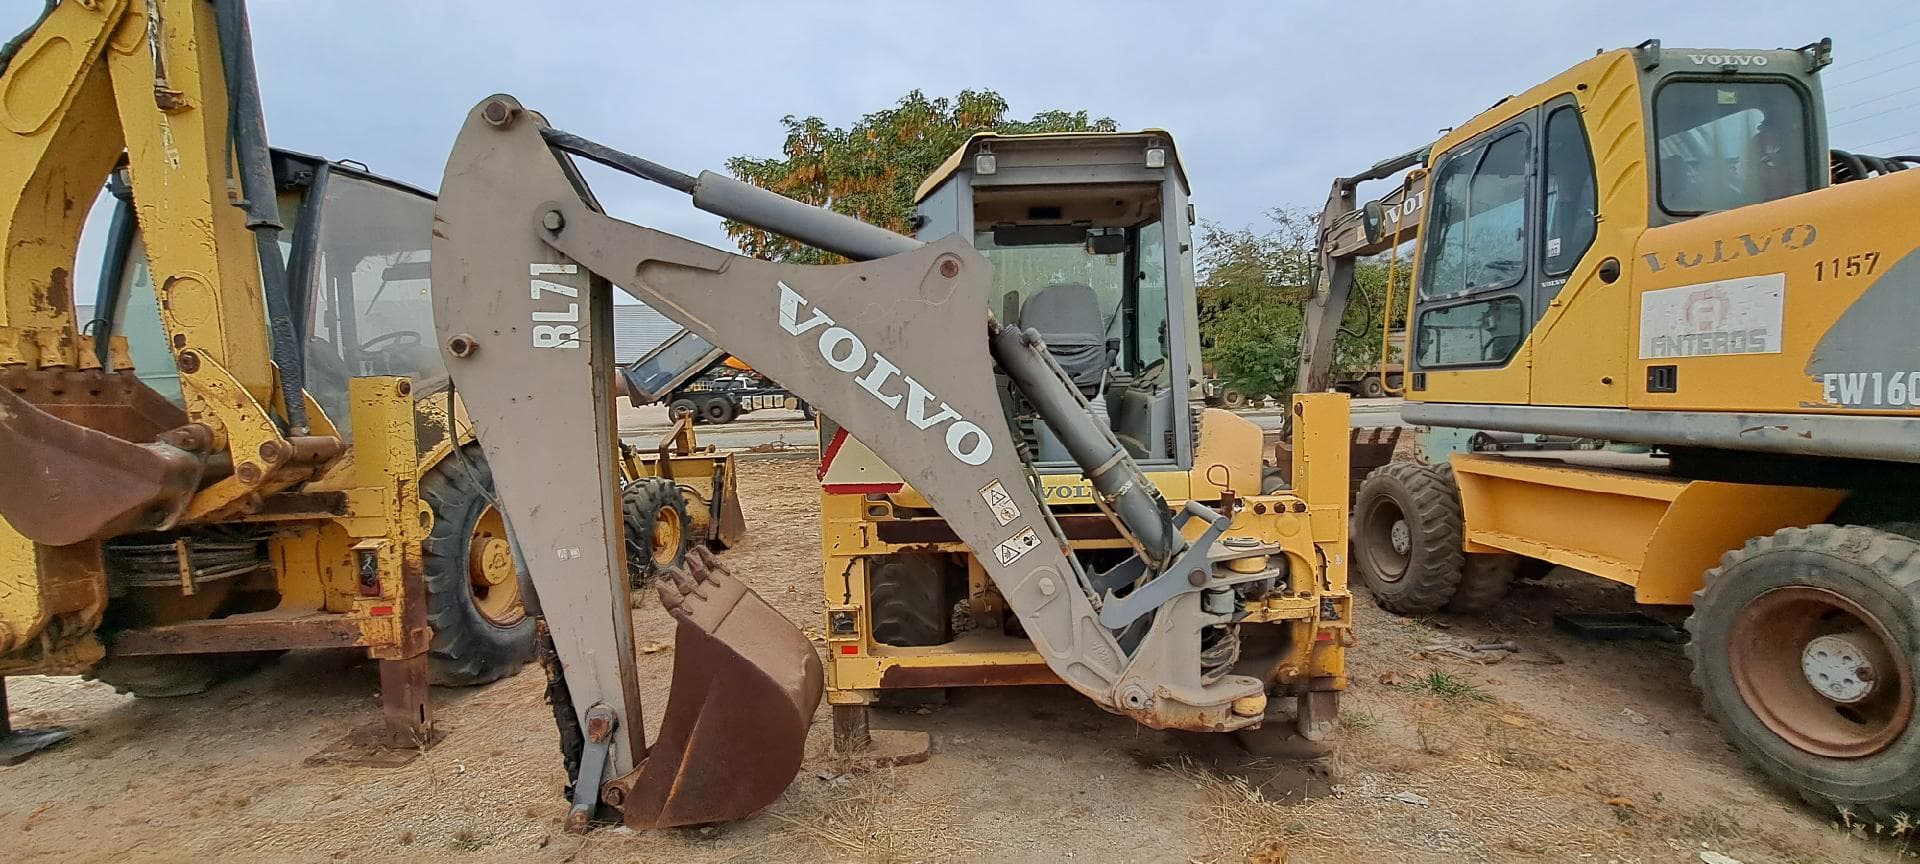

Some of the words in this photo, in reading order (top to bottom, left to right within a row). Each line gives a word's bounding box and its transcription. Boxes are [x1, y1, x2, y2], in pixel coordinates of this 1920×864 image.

[1687, 54, 1768, 66] VOLVO
[1814, 251, 1881, 282] 1157
[1541, 279, 1566, 288] VOLVO
[530, 263, 580, 349] BL71
[1651, 329, 1768, 357] ANTEROS
[777, 280, 993, 466] VOLVO
[1042, 485, 1094, 498] VOL
